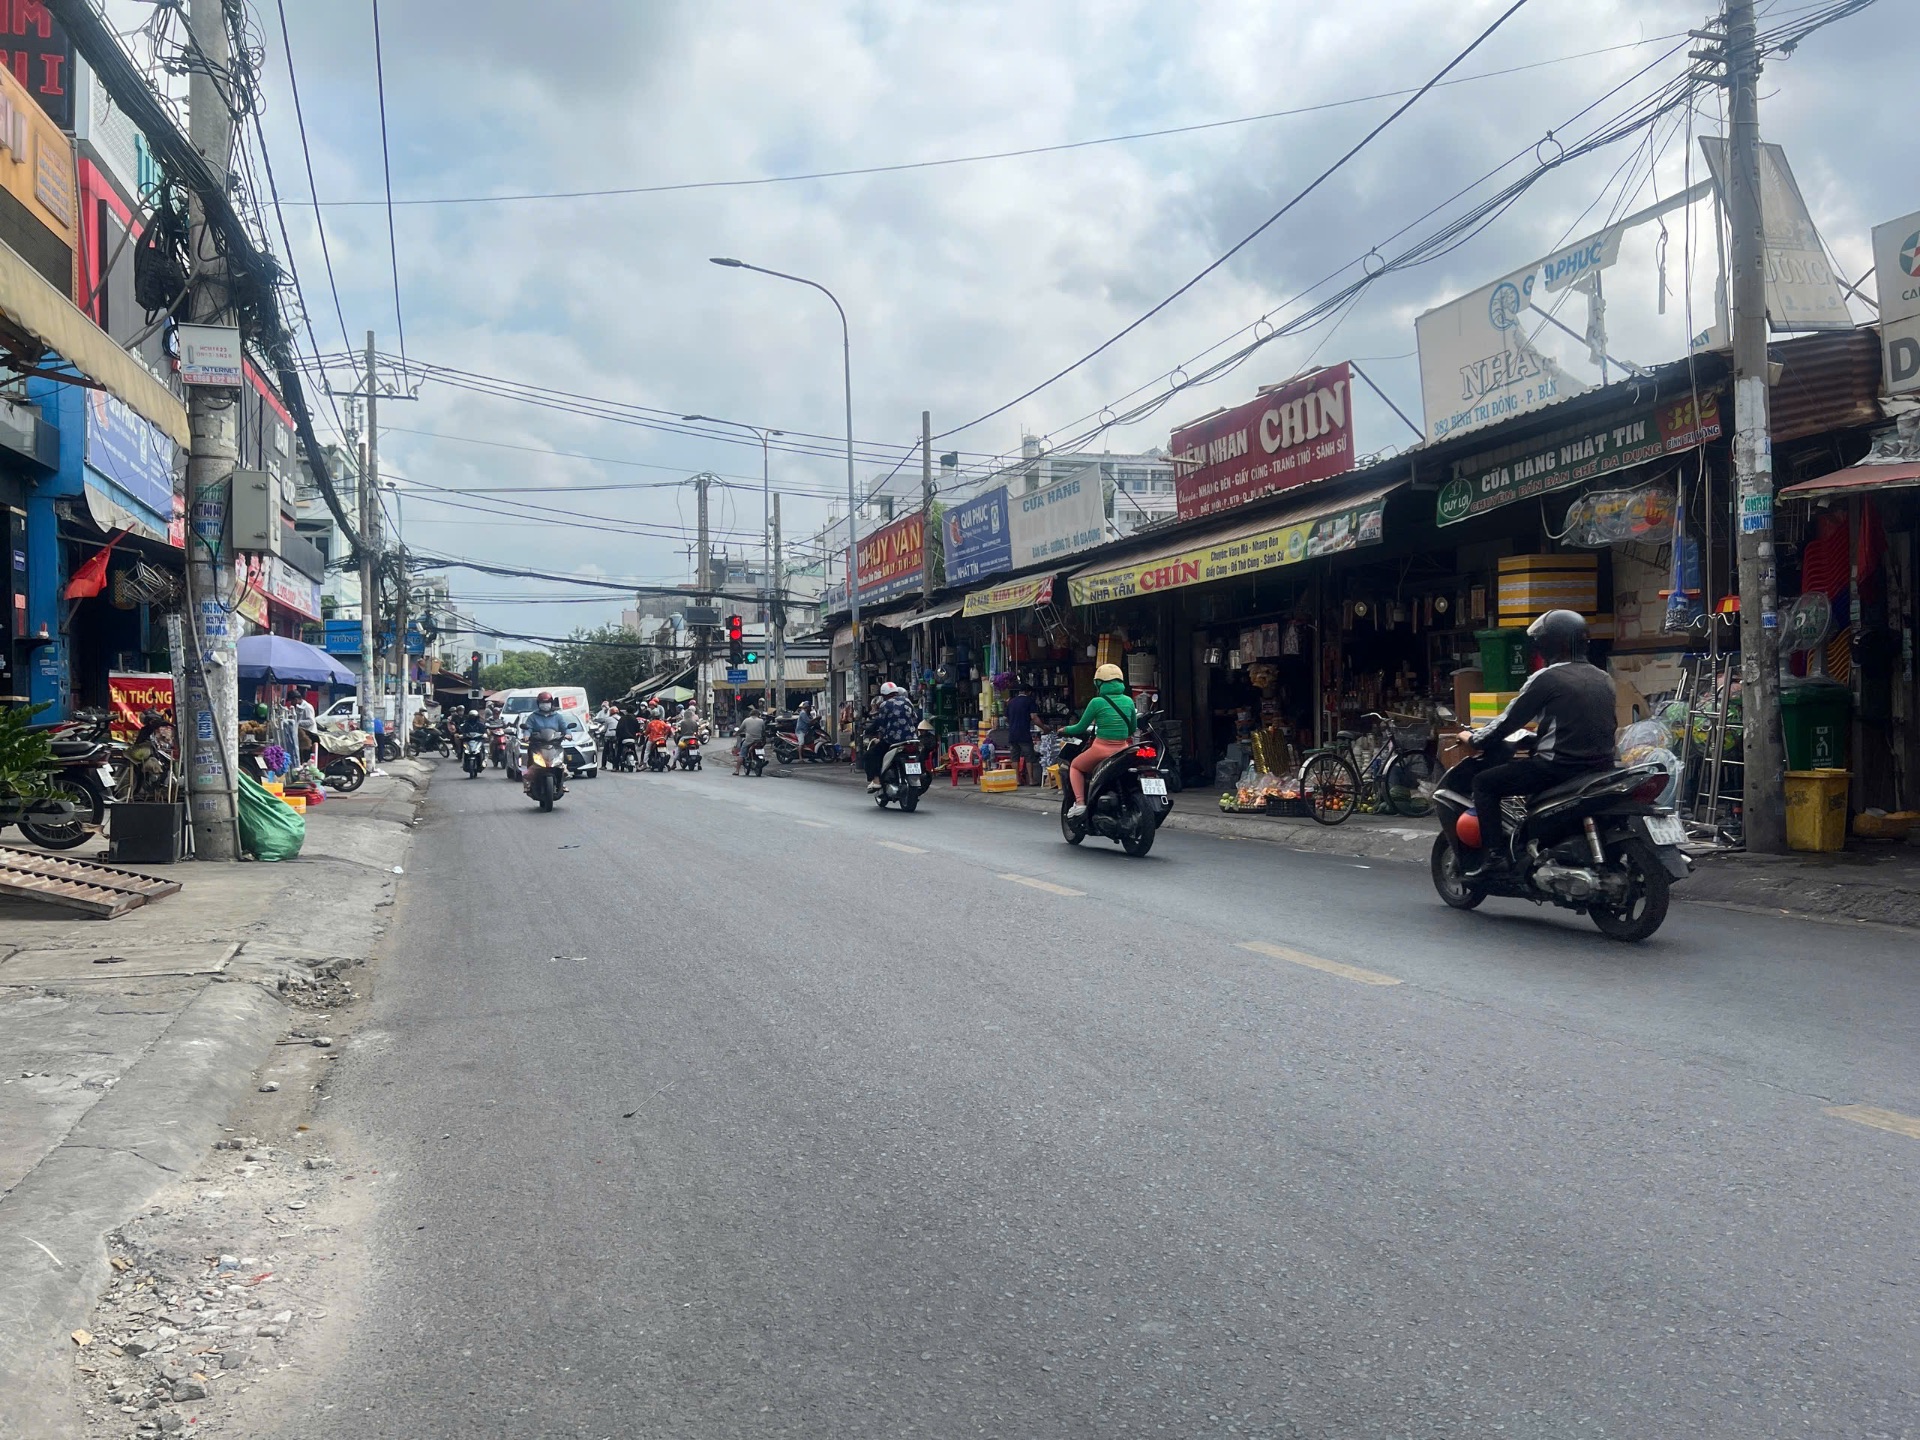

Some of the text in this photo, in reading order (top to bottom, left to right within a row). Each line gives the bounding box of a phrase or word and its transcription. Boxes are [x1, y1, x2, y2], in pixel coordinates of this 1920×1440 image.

[202, 366, 238, 374] INTERNET
[1434, 418, 1448, 436] 382
[1272, 456, 1295, 475] TRANG
[1482, 466, 1511, 493] CỬA
[1514, 451, 1556, 481] HÀNG
[1047, 480, 1081, 504] HÀNG
[1444, 500, 1458, 513] DUY
[1140, 558, 1201, 591] CHÍN
[1112, 582, 1135, 598] TÂM
[129, 687, 172, 704] THỐNG
